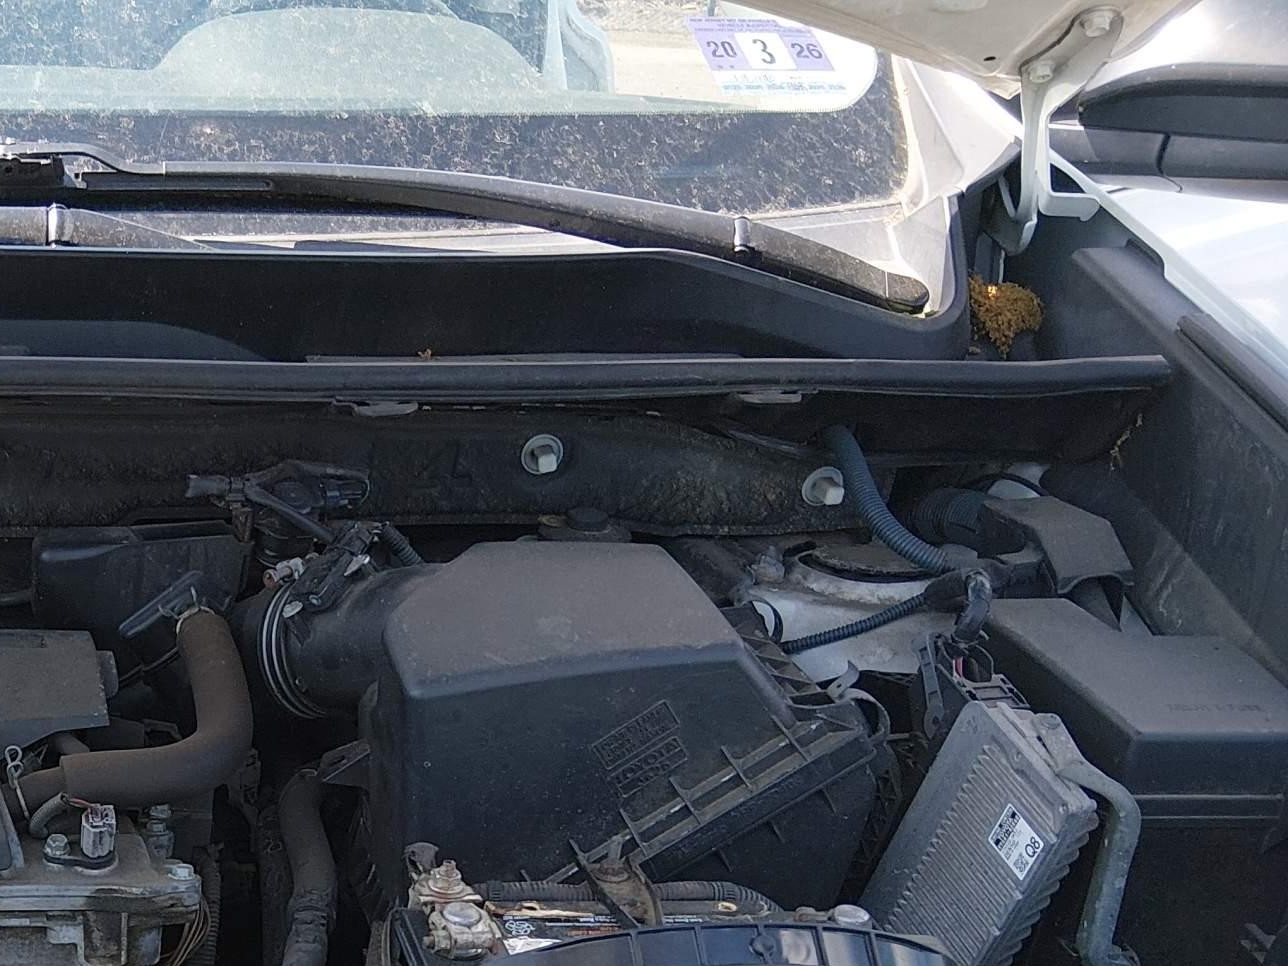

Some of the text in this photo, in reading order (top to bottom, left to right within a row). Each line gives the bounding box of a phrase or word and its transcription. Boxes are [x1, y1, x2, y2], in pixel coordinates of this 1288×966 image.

[706, 38, 823, 64] 20 3 26
[1025, 836, 1041, 858] Q8
